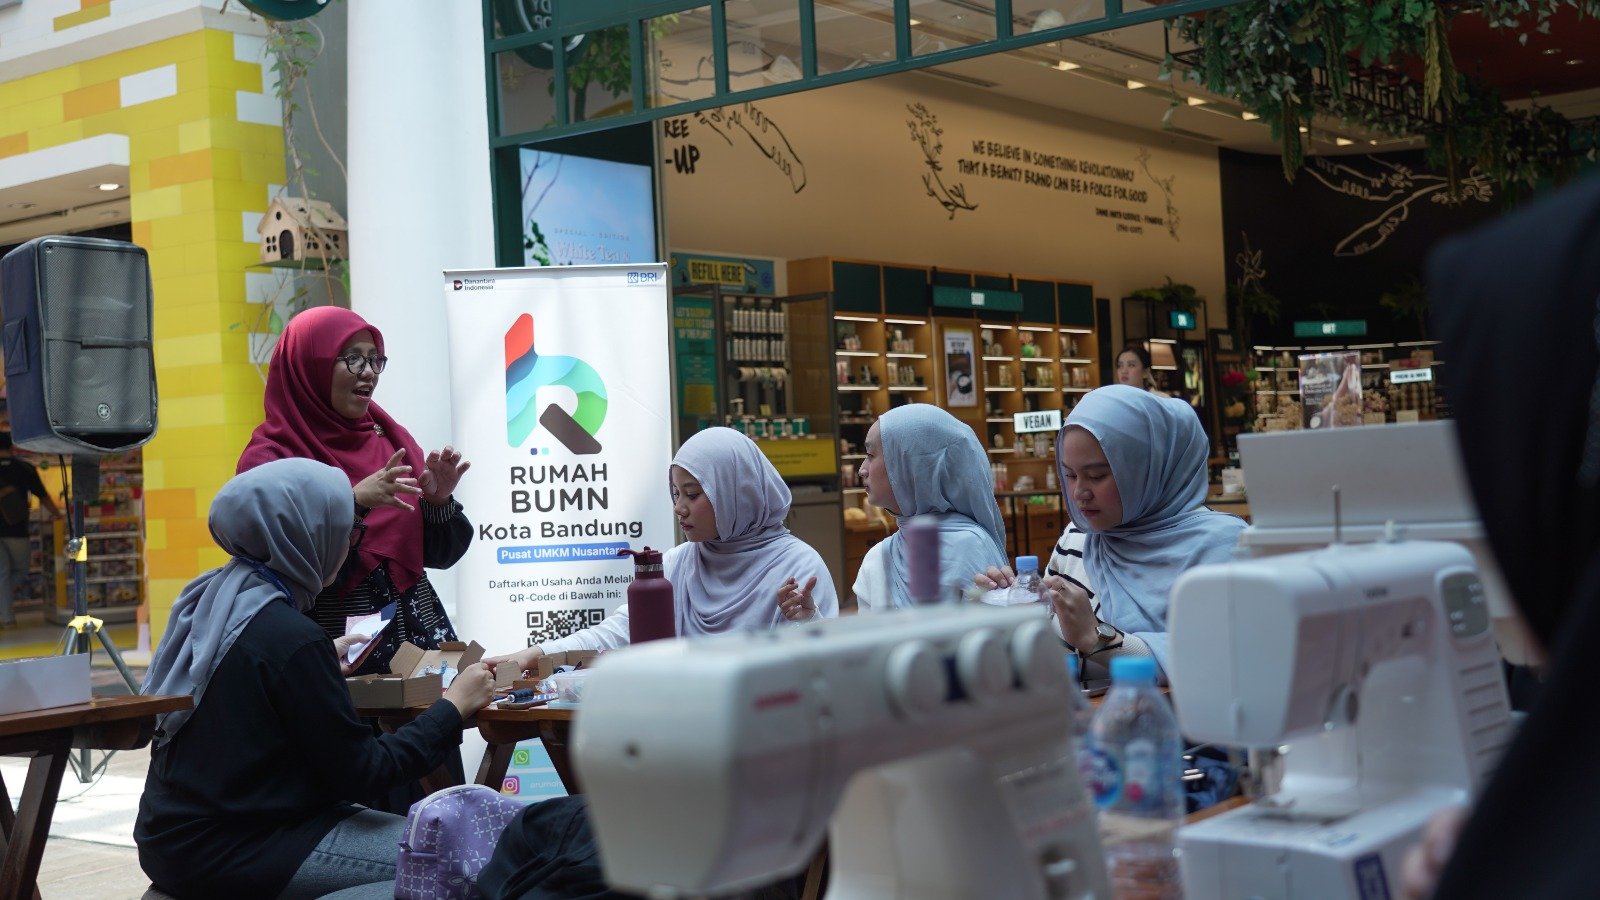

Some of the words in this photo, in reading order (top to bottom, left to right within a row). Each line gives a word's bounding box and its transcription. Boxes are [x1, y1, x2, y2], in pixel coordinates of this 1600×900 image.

[664, 119, 690, 139] REE
[665, 144, 701, 175] -UP
[972, 140, 985, 156] WE
[987, 141, 1021, 162] BELIEVE
[1022, 149, 1032, 163] IN
[1033, 151, 1078, 172] SOMETHING
[1079, 160, 1135, 182] REVOLUTIONARY
[957, 159, 980, 176] THAT
[981, 163, 989, 177] A
[990, 163, 1022, 182] BEAUTY
[1024, 169, 1053, 188] BRAND
[1053, 176, 1069, 191] CAN
[1070, 178, 1081, 193] BE
[1082, 180, 1089, 194] A
[1089, 182, 1113, 198] FORCE
[1113, 186, 1128, 201] FOR
[1128, 188, 1148, 204] GOOD
[640, 272, 658, 283] BRI
[691, 261, 719, 280] REFILL
[720, 264, 743, 284] HERE
[1023, 414, 1052, 429] VEGAN
[510, 463, 608, 485] RUMAH
[511, 486, 609, 514] BUMN
[479, 523, 532, 541] Kota
[540, 519, 643, 538] Bandung
[501, 549, 532, 559] Pusat
[533, 547, 570, 559] UMKM
[489, 579, 539, 589] Daftarkan
[541, 578, 573, 587] Usaha
[575, 576, 602, 585] Anda
[509, 593, 556, 603] QR-Code
[558, 592, 568, 600] di
[570, 591, 604, 600] Bawah
[606, 589, 622, 598] ini:
